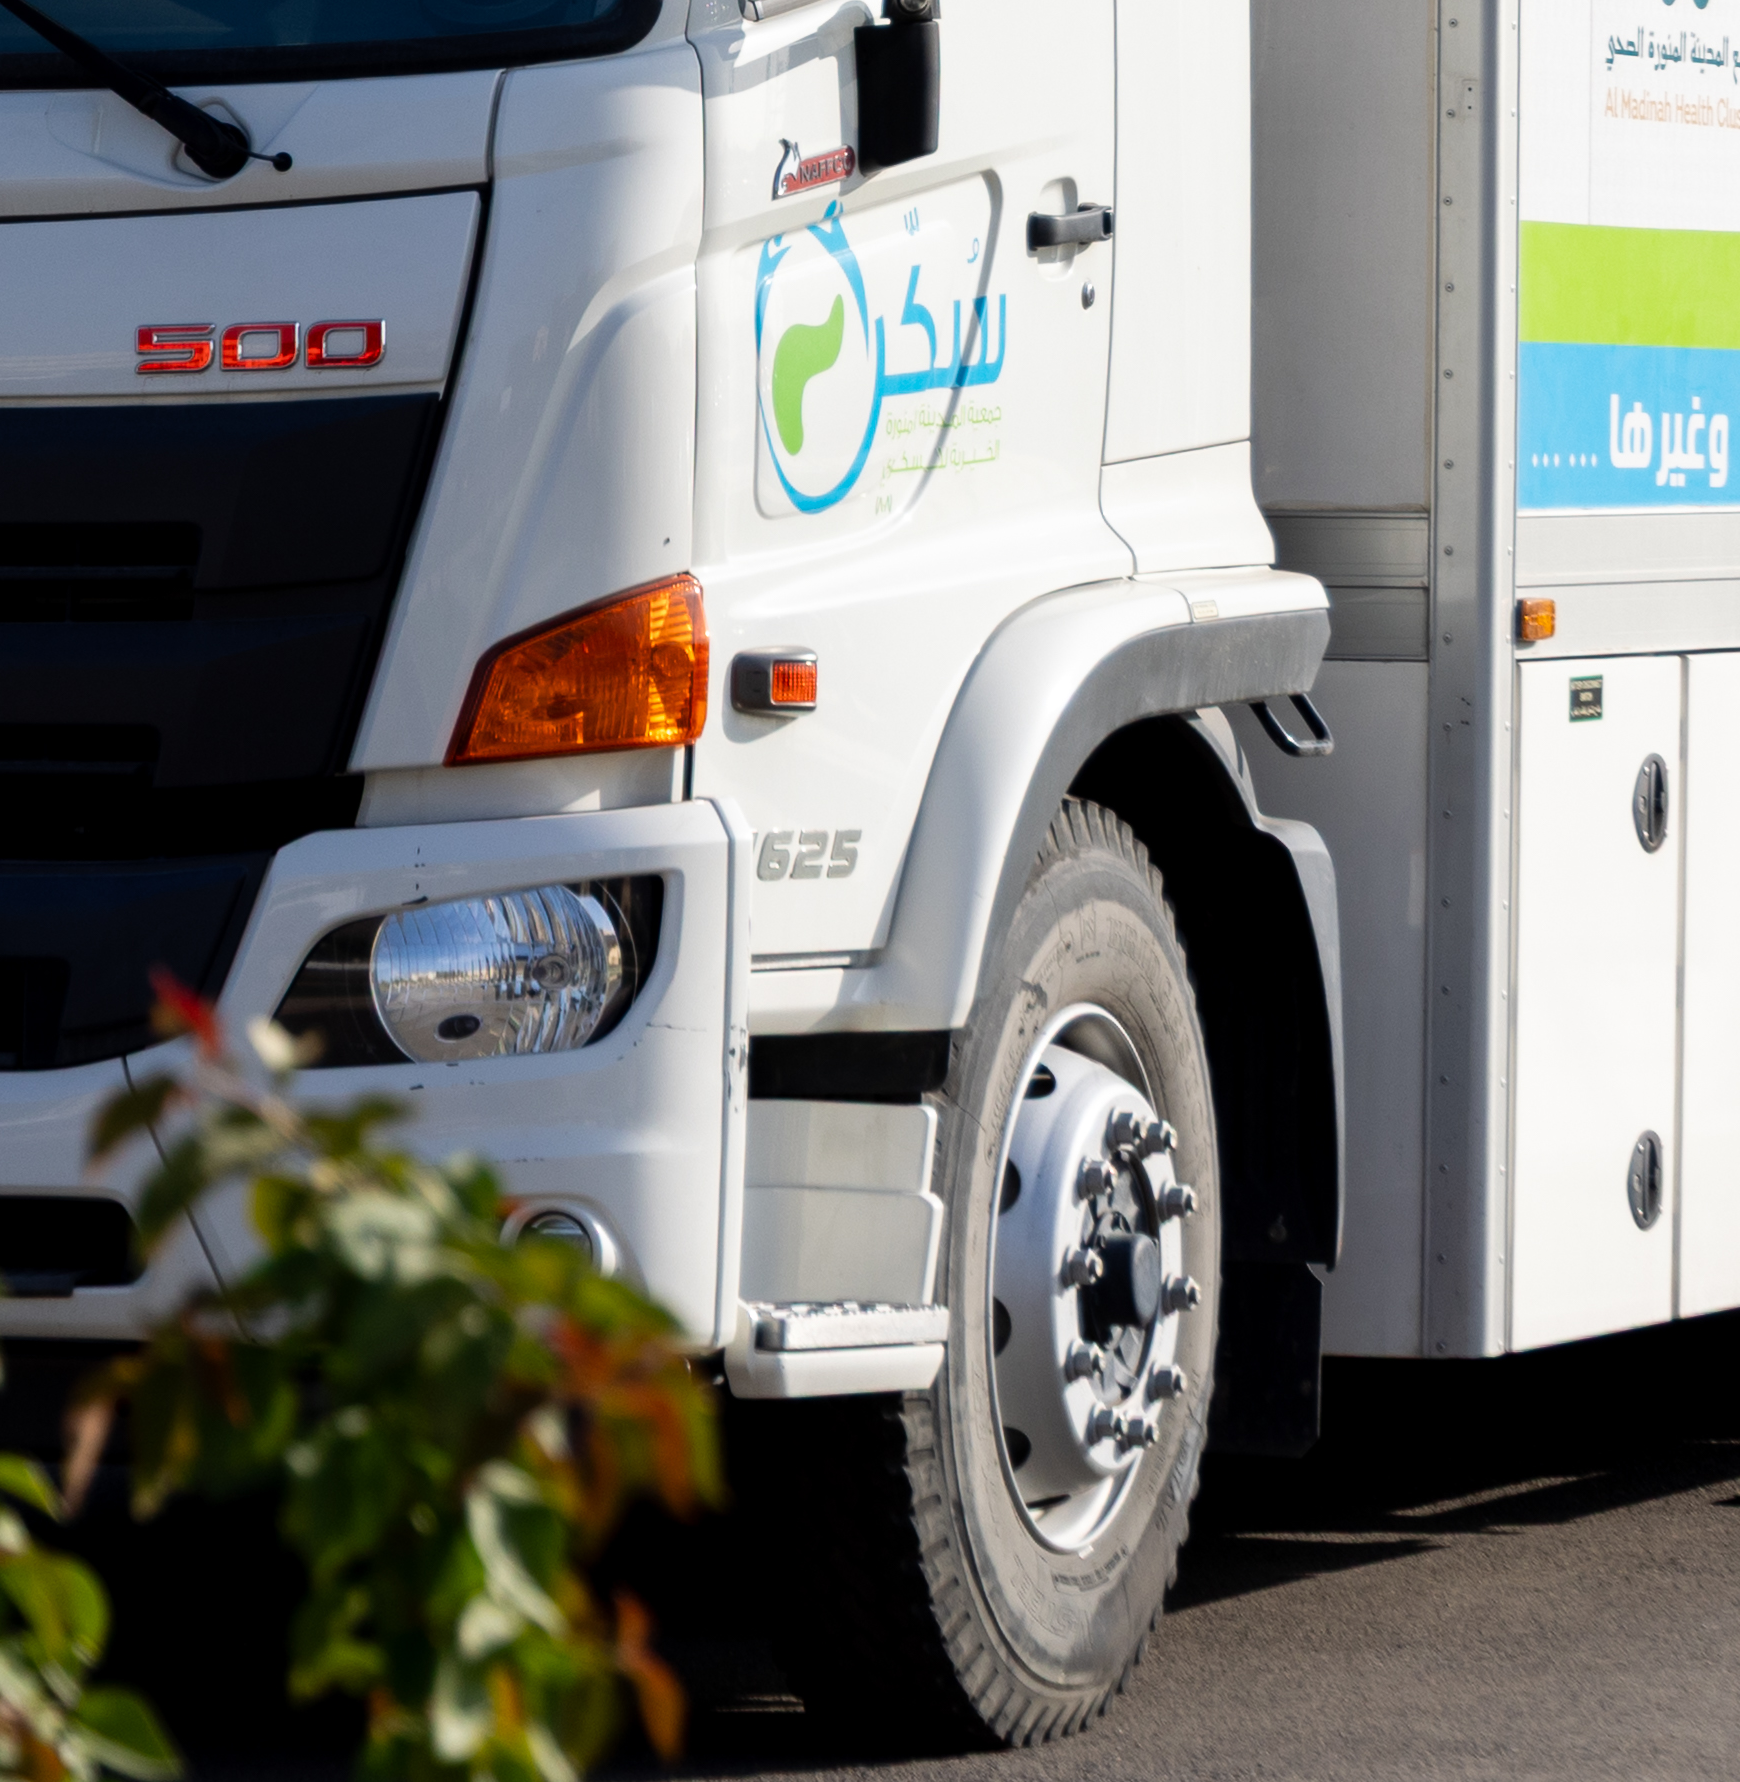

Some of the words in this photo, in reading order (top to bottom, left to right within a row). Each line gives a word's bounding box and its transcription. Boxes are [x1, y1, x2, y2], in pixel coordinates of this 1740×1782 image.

[1605, 26, 1644, 71] الصحي
[1648, 31, 1687, 71] المنورة
[1691, 31, 1730, 74] المدينة
[1604, 87, 1618, 118] Al
[1621, 89, 1672, 122] Madinah
[1675, 94, 1714, 127] Health
[800, 155, 852, 184] NAFFCO
[135, 319, 386, 374] 500
[1609, 393, 1729, 488] وغيرها
[752, 828, 862, 881] 625
